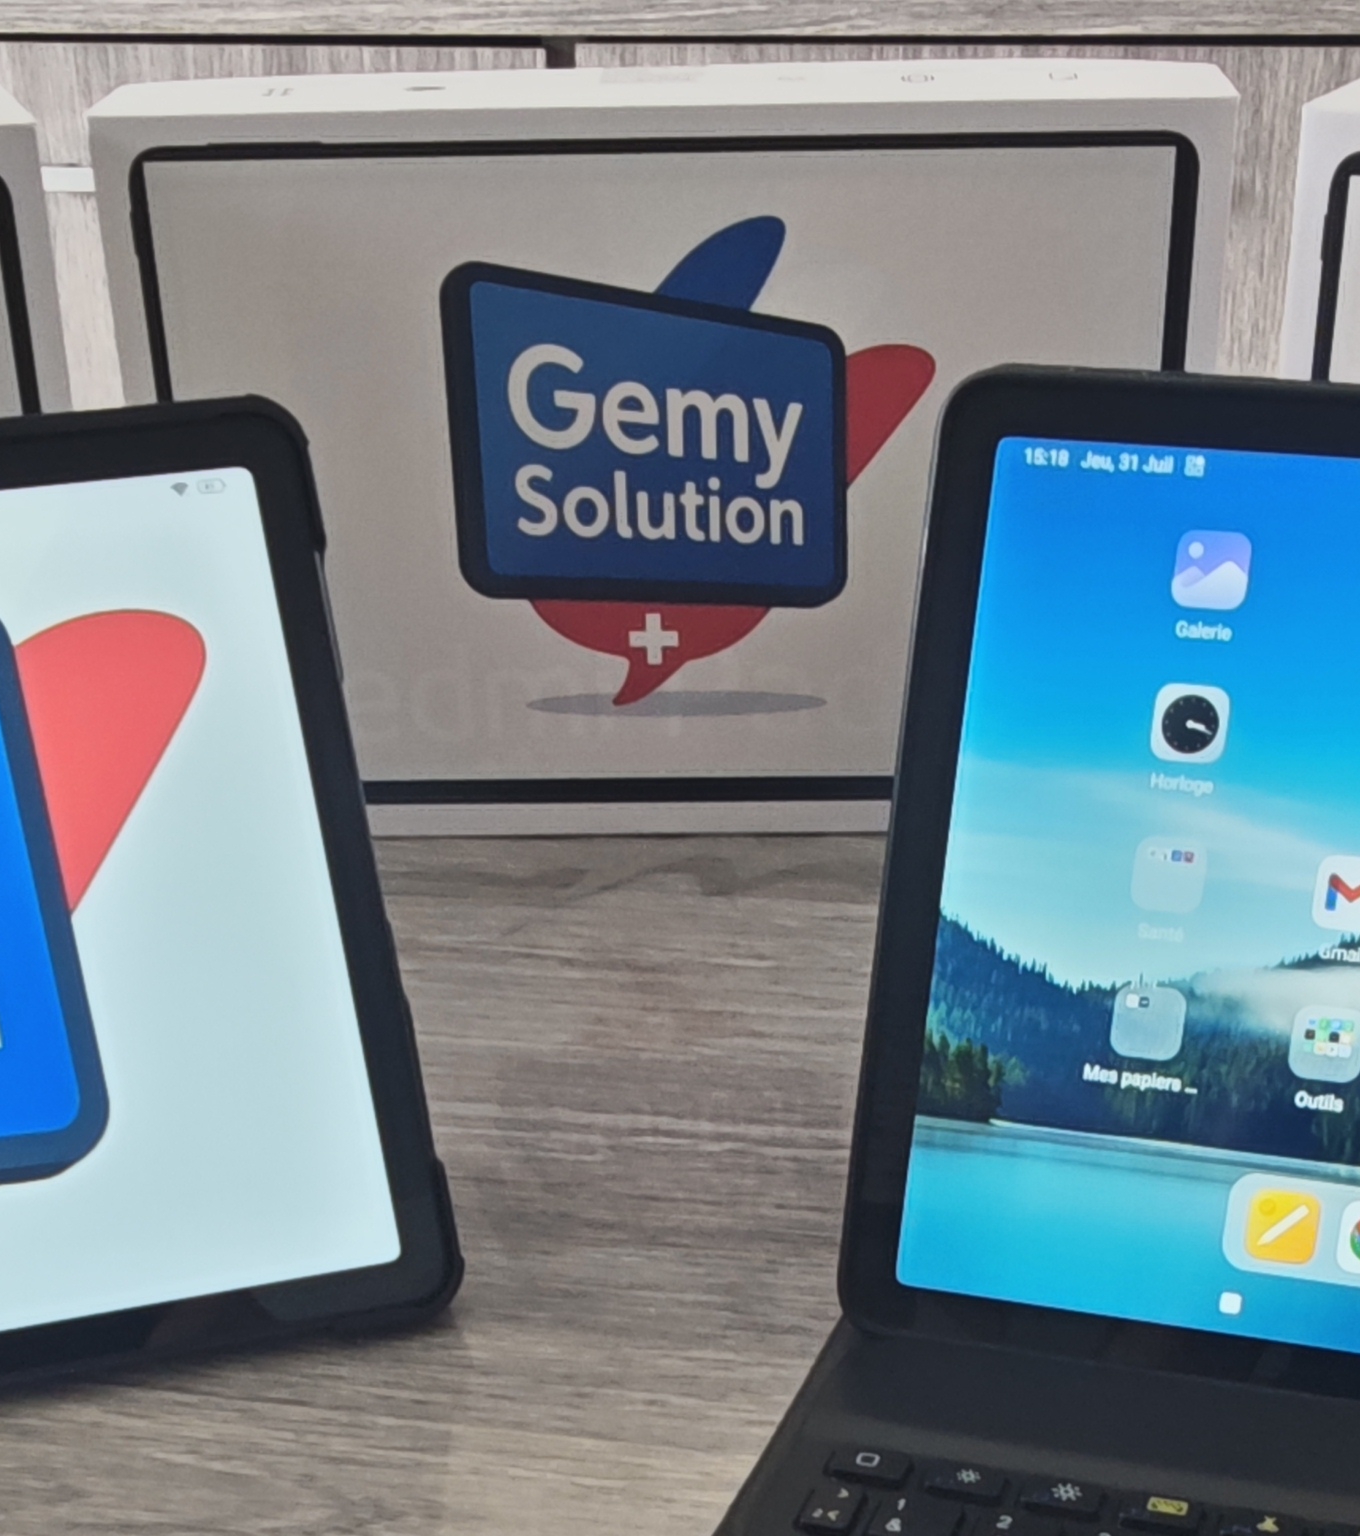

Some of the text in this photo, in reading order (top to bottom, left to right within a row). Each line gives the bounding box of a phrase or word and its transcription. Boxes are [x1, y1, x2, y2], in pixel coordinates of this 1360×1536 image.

[508, 343, 803, 489] Gemy
[1118, 452, 1139, 472] 31
[515, 464, 804, 545] Solution
[1175, 620, 1233, 641] Galerie
[1150, 772, 1214, 798] Horloge
[1083, 1063, 1118, 1085] Mes
[1120, 1071, 1182, 1093] papiers
[1294, 1090, 1344, 1113] Outils
[995, 1514, 1013, 1530] 2
